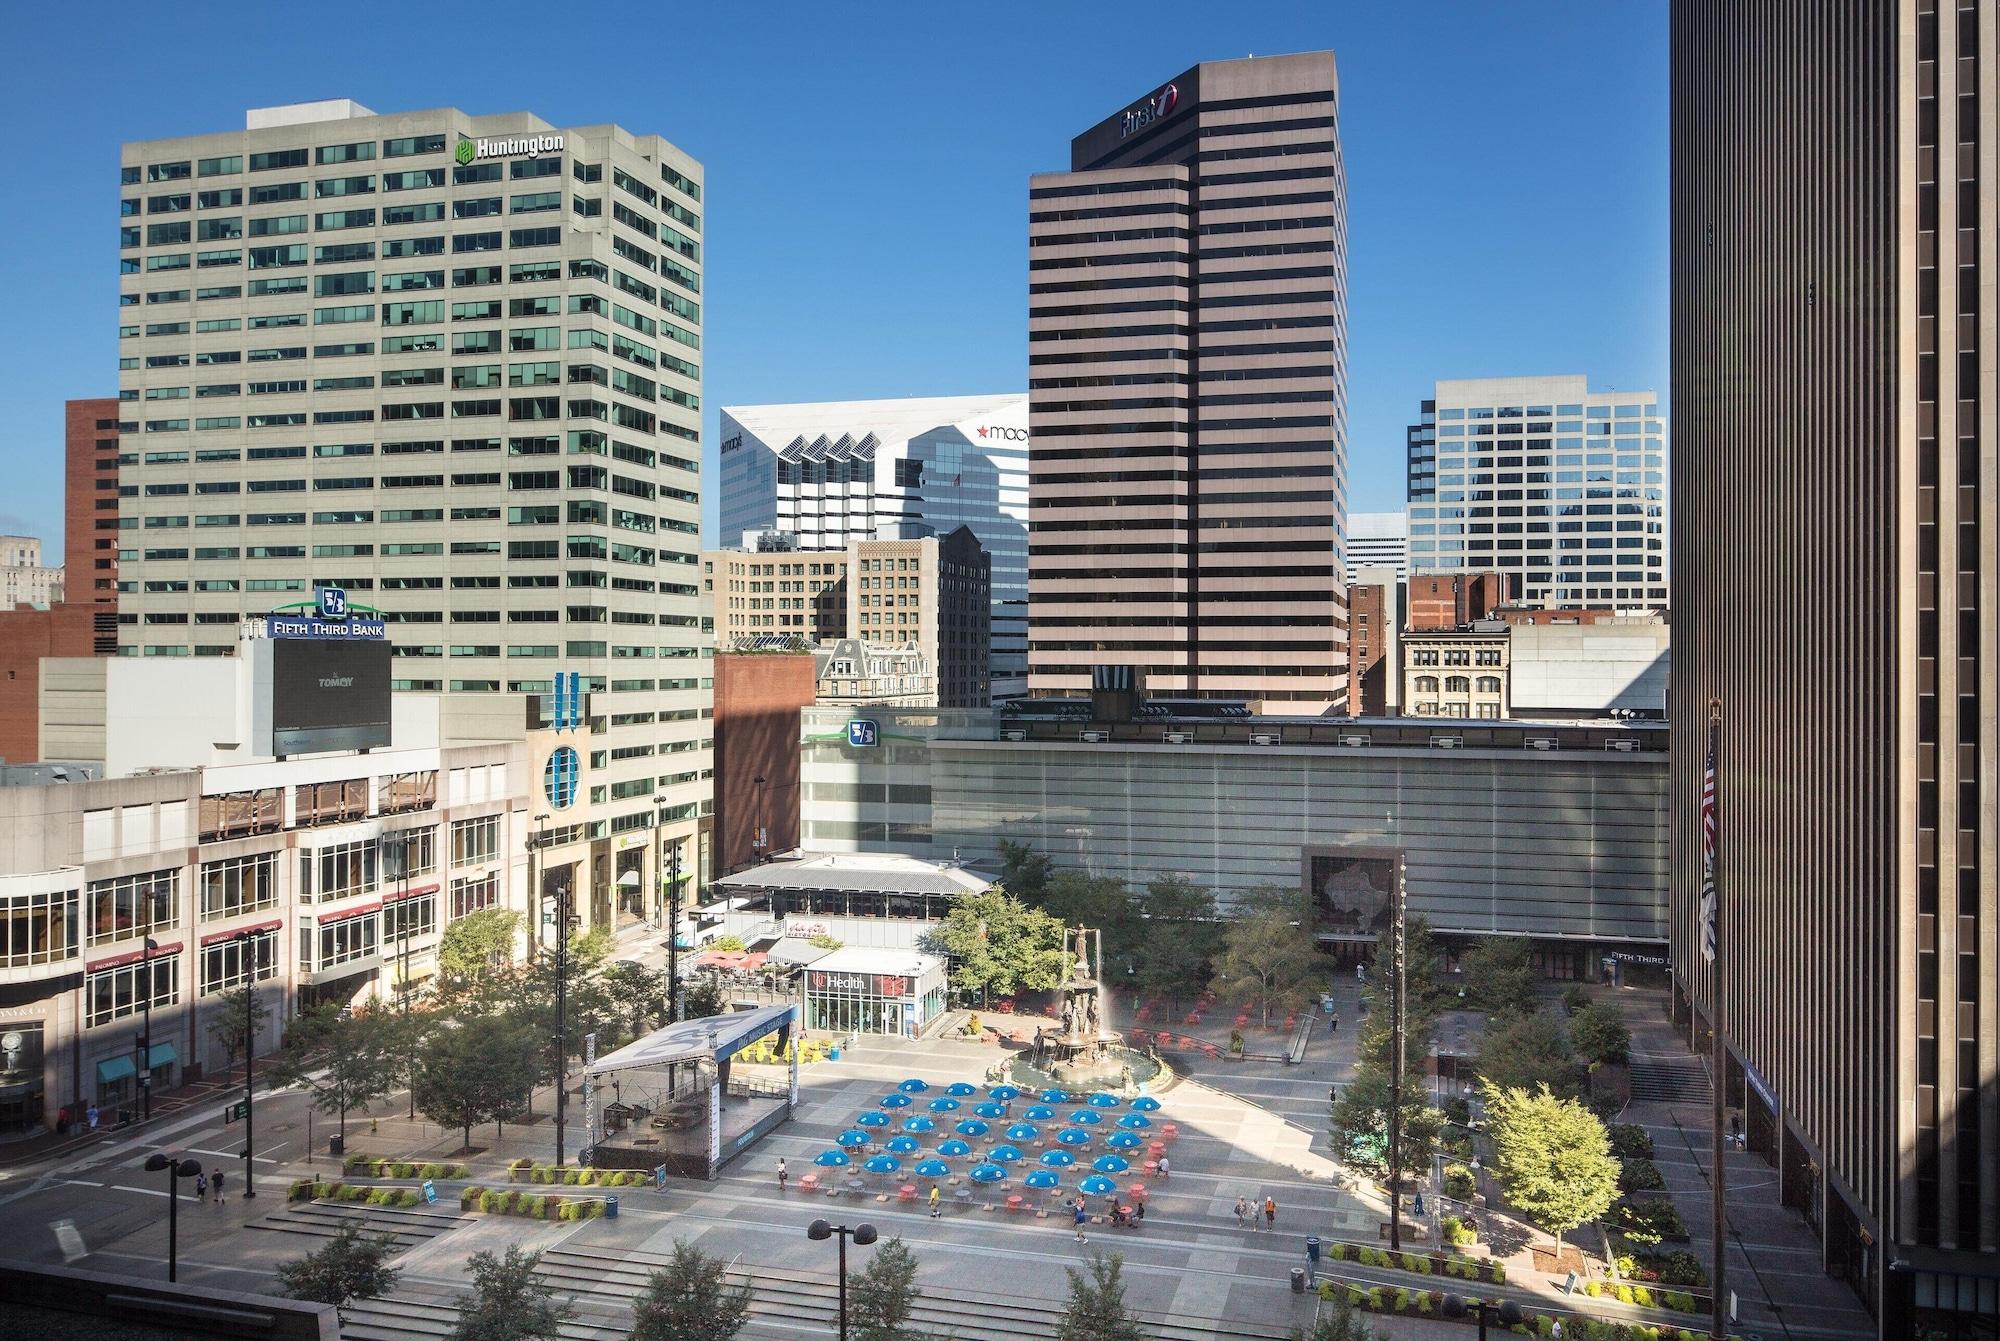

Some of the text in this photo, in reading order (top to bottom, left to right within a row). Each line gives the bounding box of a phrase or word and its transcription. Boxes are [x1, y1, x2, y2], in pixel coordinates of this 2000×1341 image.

[1120, 98, 1156, 139] First
[477, 135, 563, 158] Huntington
[274, 621, 384, 636] FIFTH THIRD BANK
[1611, 951, 1634, 961] FIFTH
[1636, 954, 1665, 964] THIRD
[767, 1016, 783, 1032] STAGE
